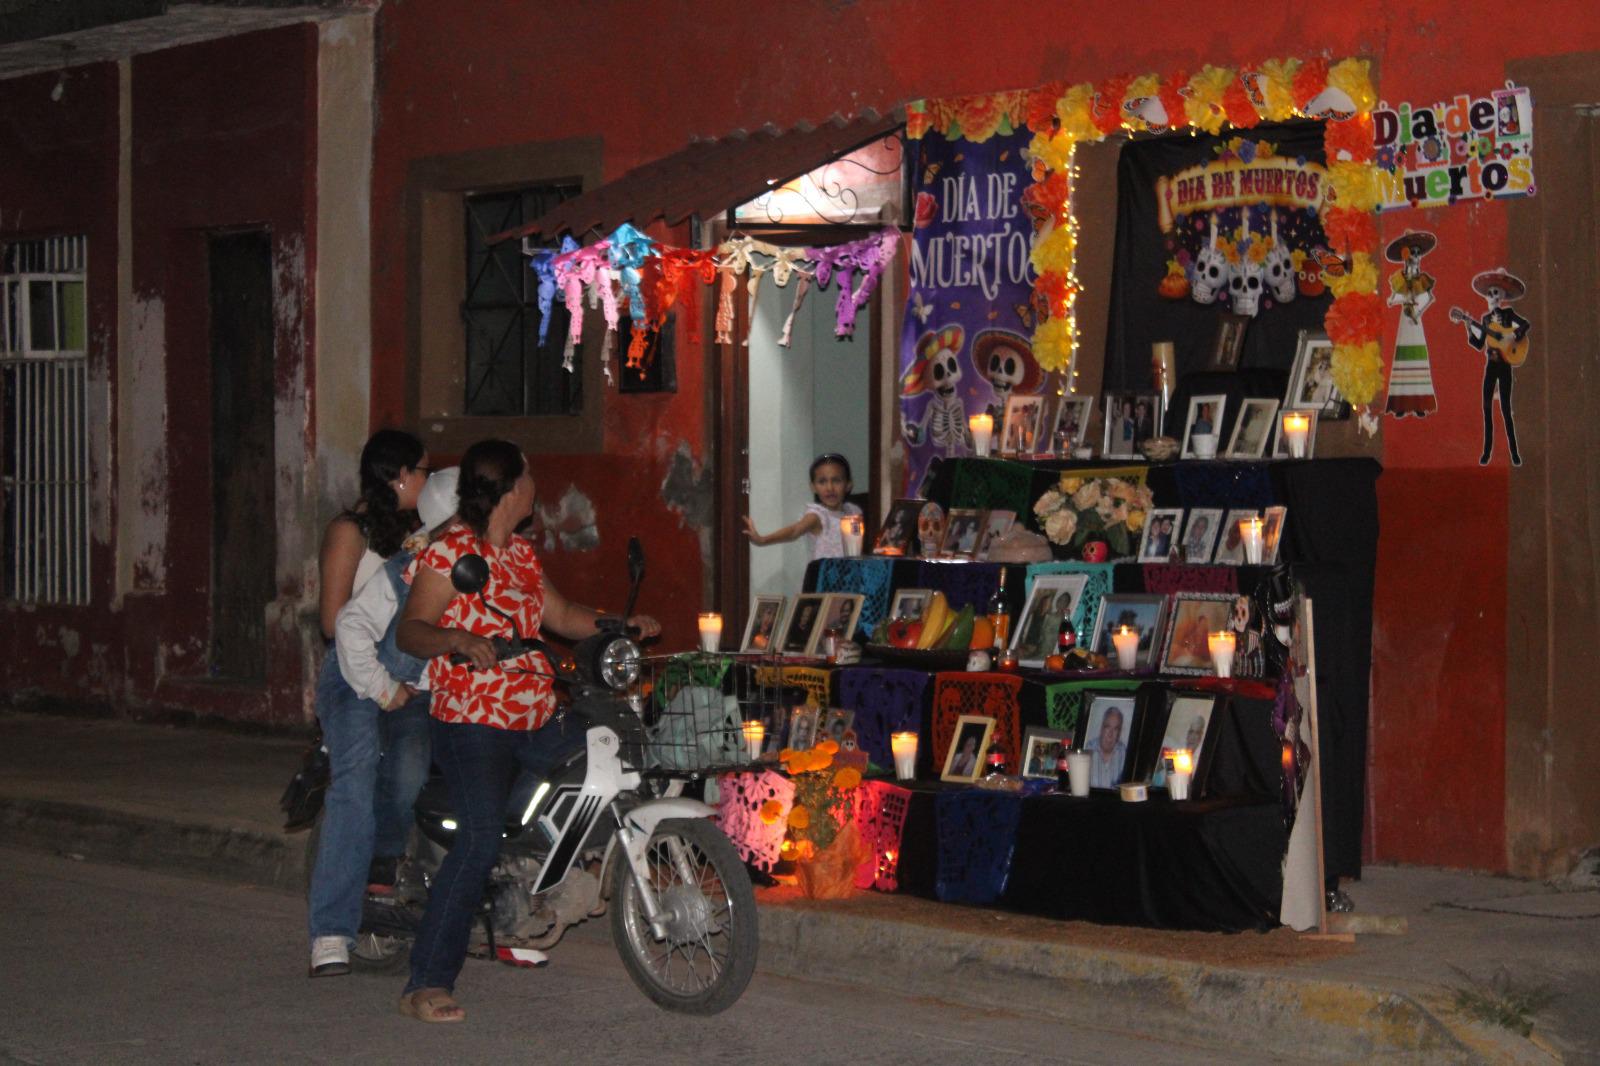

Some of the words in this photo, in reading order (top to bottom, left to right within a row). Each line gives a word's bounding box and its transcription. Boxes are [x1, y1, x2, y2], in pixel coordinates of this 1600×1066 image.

[1373, 103, 1437, 146] Dia
[1445, 96, 1495, 133] de
[942, 171, 980, 223] DÍA
[987, 172, 1018, 220] DE
[1176, 175, 1208, 206] DIA
[1212, 172, 1235, 200] DE
[1239, 167, 1320, 200] MUERTOS
